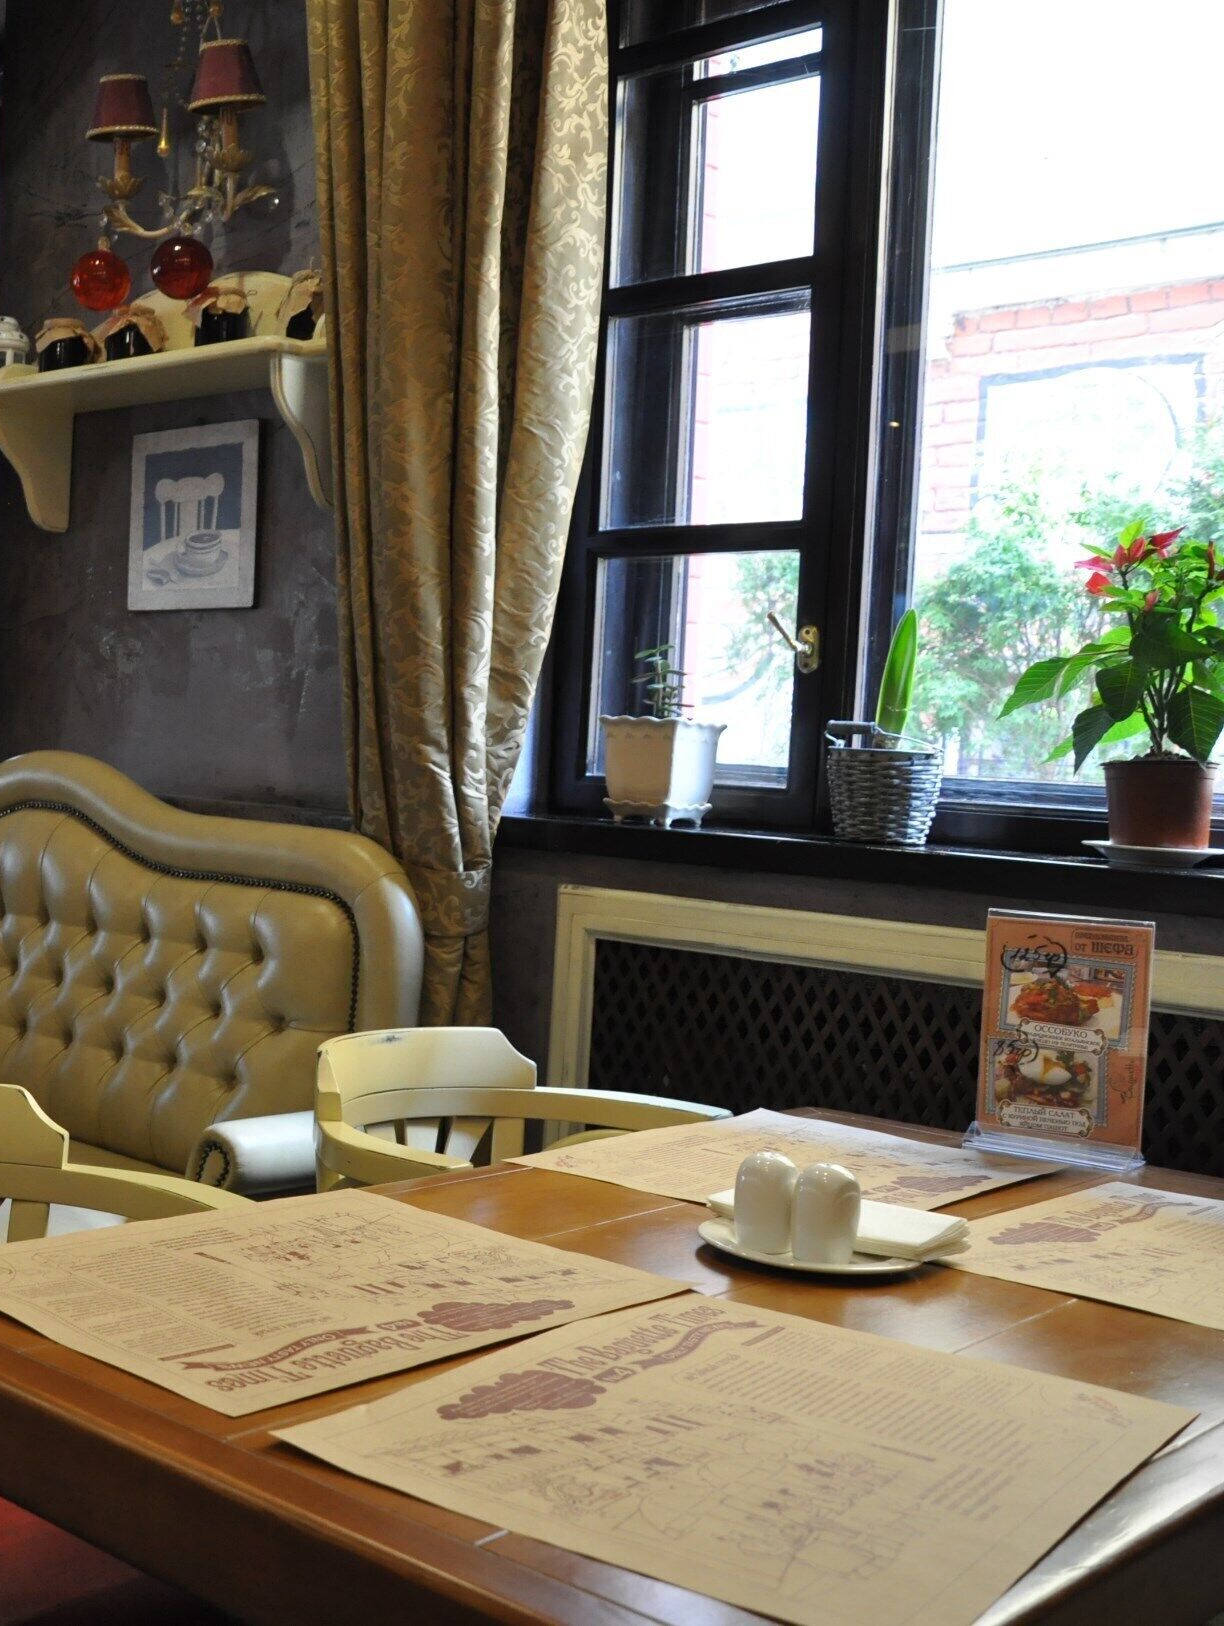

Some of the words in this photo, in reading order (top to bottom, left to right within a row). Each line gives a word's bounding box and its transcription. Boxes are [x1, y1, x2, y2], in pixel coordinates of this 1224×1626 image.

[1034, 1024, 1088, 1039] ОССОБУКО
[1048, 1109, 1075, 1120] САЛАТ
[265, 1342, 300, 1365] TASTY
[292, 1334, 421, 1372] Baguette
[205, 1366, 315, 1393] Times
